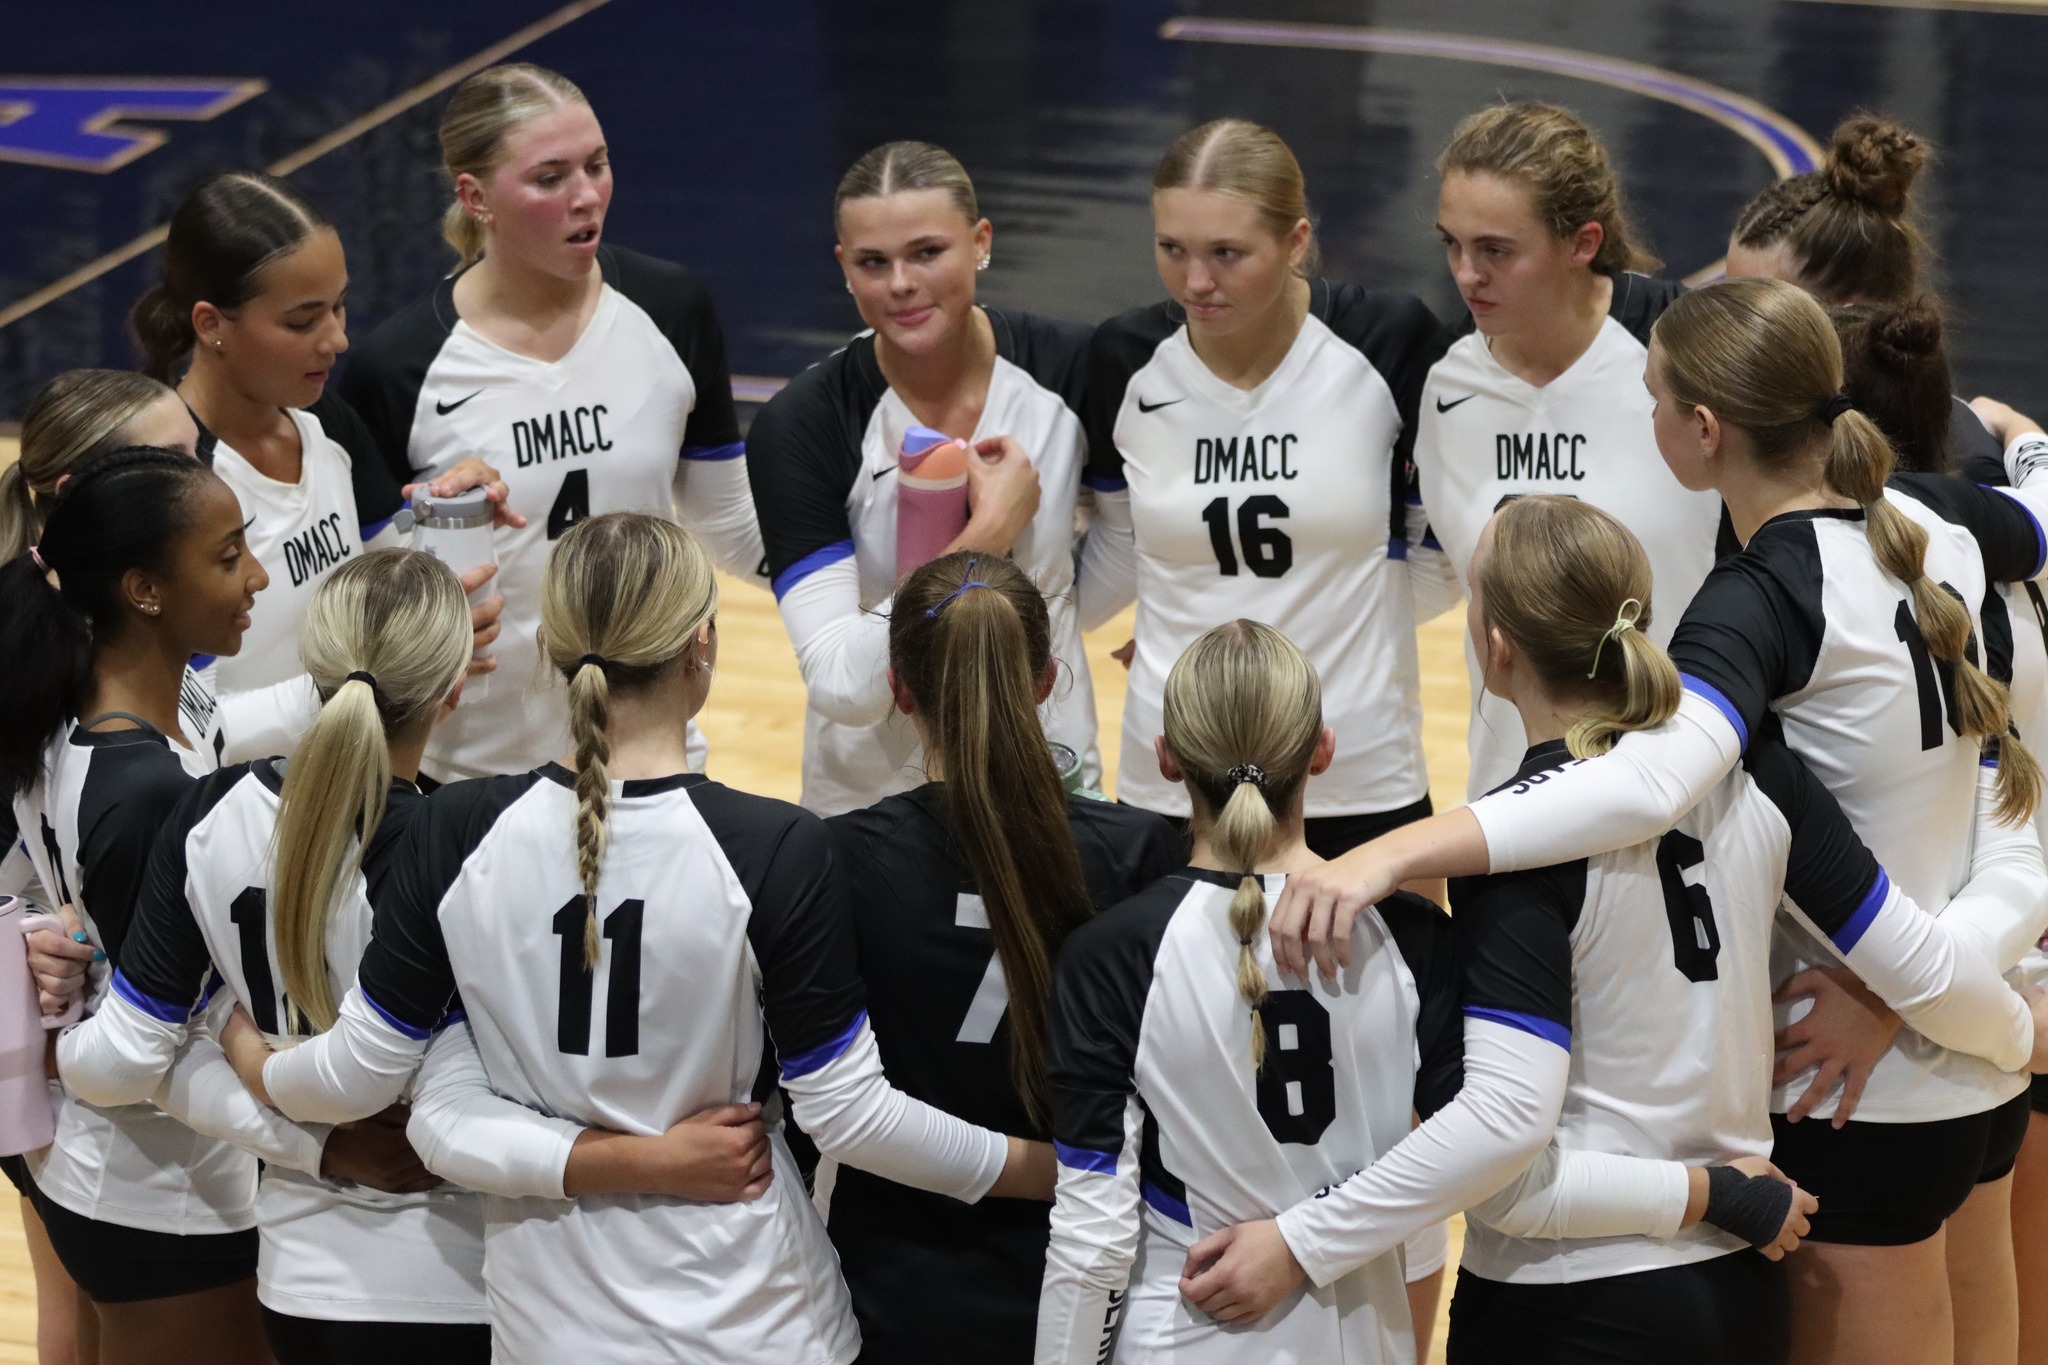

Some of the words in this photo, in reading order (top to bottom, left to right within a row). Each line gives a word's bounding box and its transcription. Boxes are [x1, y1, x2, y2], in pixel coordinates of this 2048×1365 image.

[512, 404, 613, 468] DMACC
[1194, 434, 1299, 484] DMACC
[1496, 433, 1587, 481] DMACC
[547, 468, 590, 541] 4
[1202, 495, 1293, 579] 16
[283, 512, 350, 588] DMACC
[1894, 581, 1980, 751] 1
[1656, 829, 1721, 983] 6
[553, 894, 645, 1058] 11
[955, 892, 1012, 1044] 7
[1251, 989, 1336, 1146] 8
